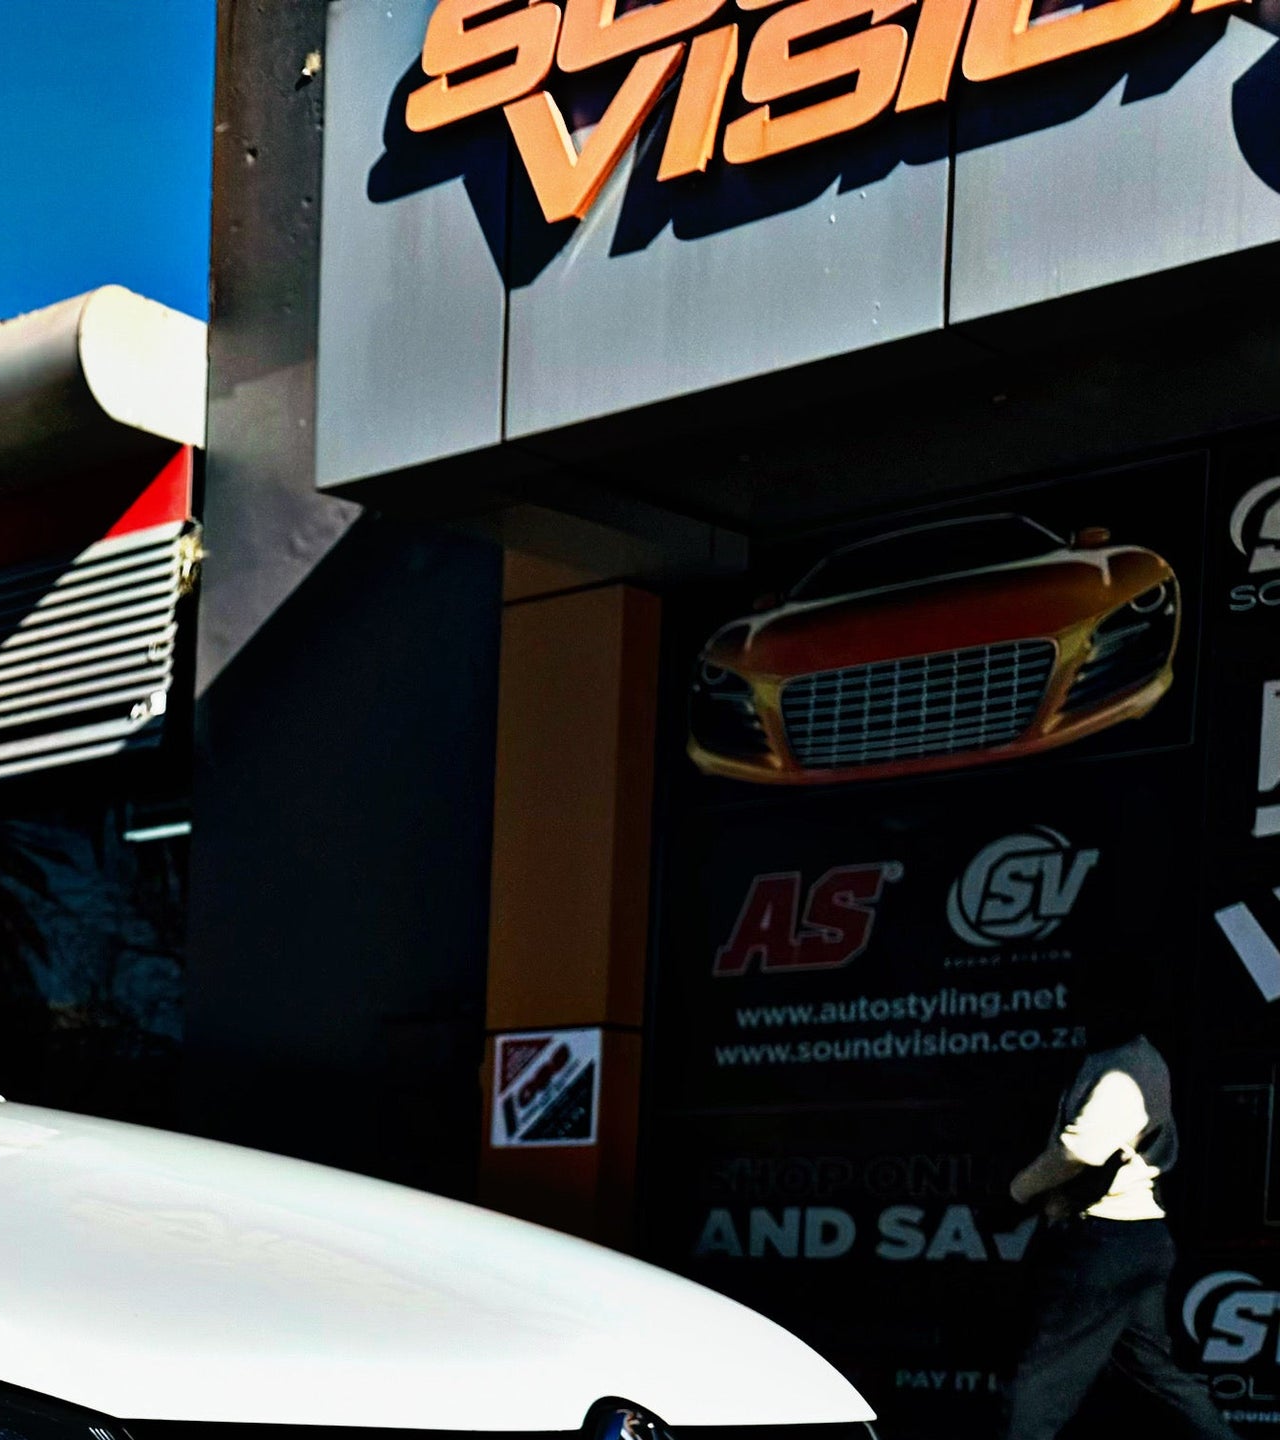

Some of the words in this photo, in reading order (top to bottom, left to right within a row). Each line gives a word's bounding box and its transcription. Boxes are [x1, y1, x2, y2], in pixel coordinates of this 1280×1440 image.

[736, 981, 1070, 1030] www.autostyling.net
[712, 1024, 1088, 1068] www.soundvision.co.za
[693, 1204, 857, 1261] AND
